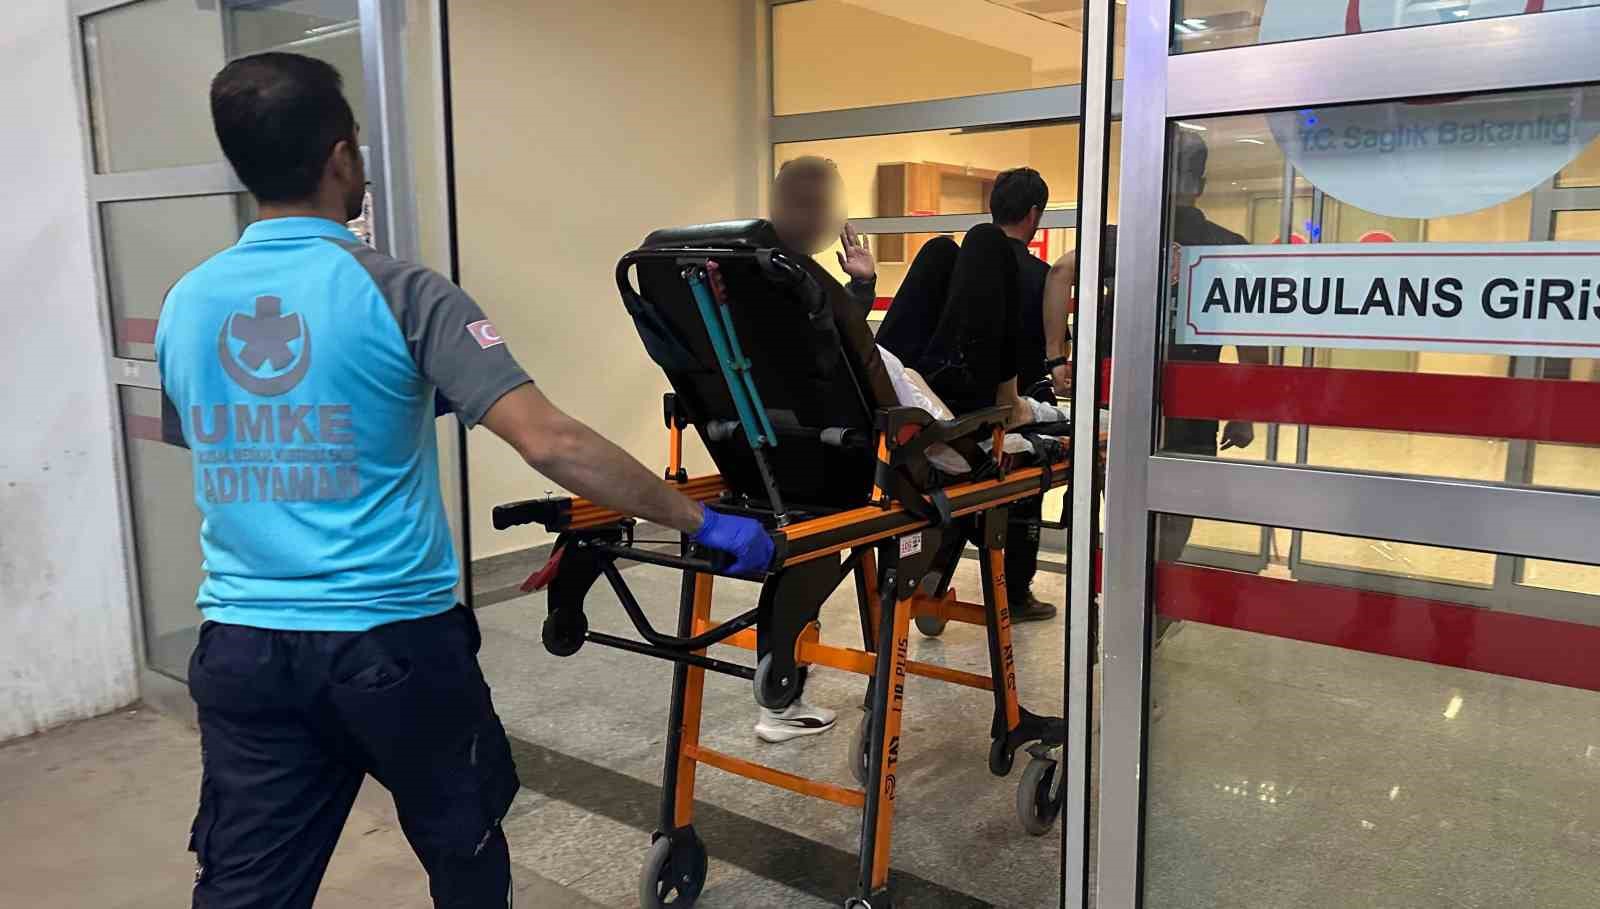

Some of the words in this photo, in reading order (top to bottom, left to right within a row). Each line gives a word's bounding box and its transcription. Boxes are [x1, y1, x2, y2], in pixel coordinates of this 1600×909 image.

[1201, 276, 1463, 318] AMBULANS
[1481, 277, 1600, 321] GiRi
[191, 404, 353, 444] UMKE
